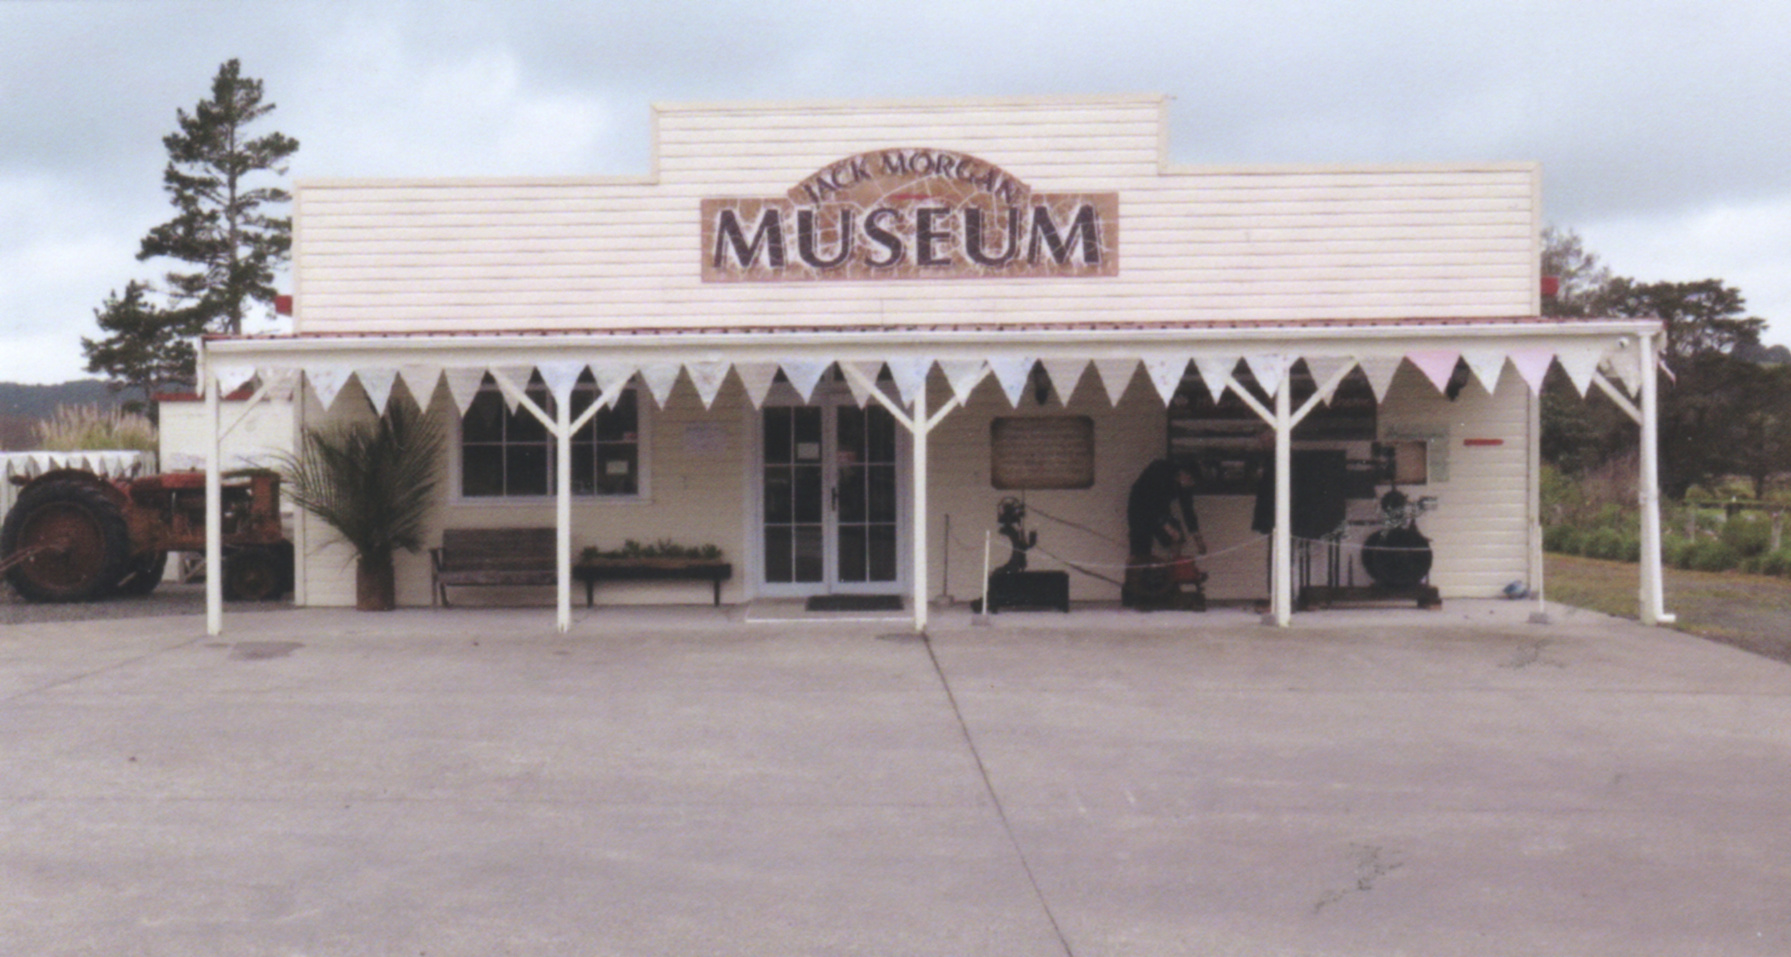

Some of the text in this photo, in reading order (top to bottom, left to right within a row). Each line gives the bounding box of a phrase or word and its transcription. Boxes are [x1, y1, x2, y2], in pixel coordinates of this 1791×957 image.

[803, 149, 1021, 206] JACK MORGAN
[713, 204, 1101, 270] MUSEUM
